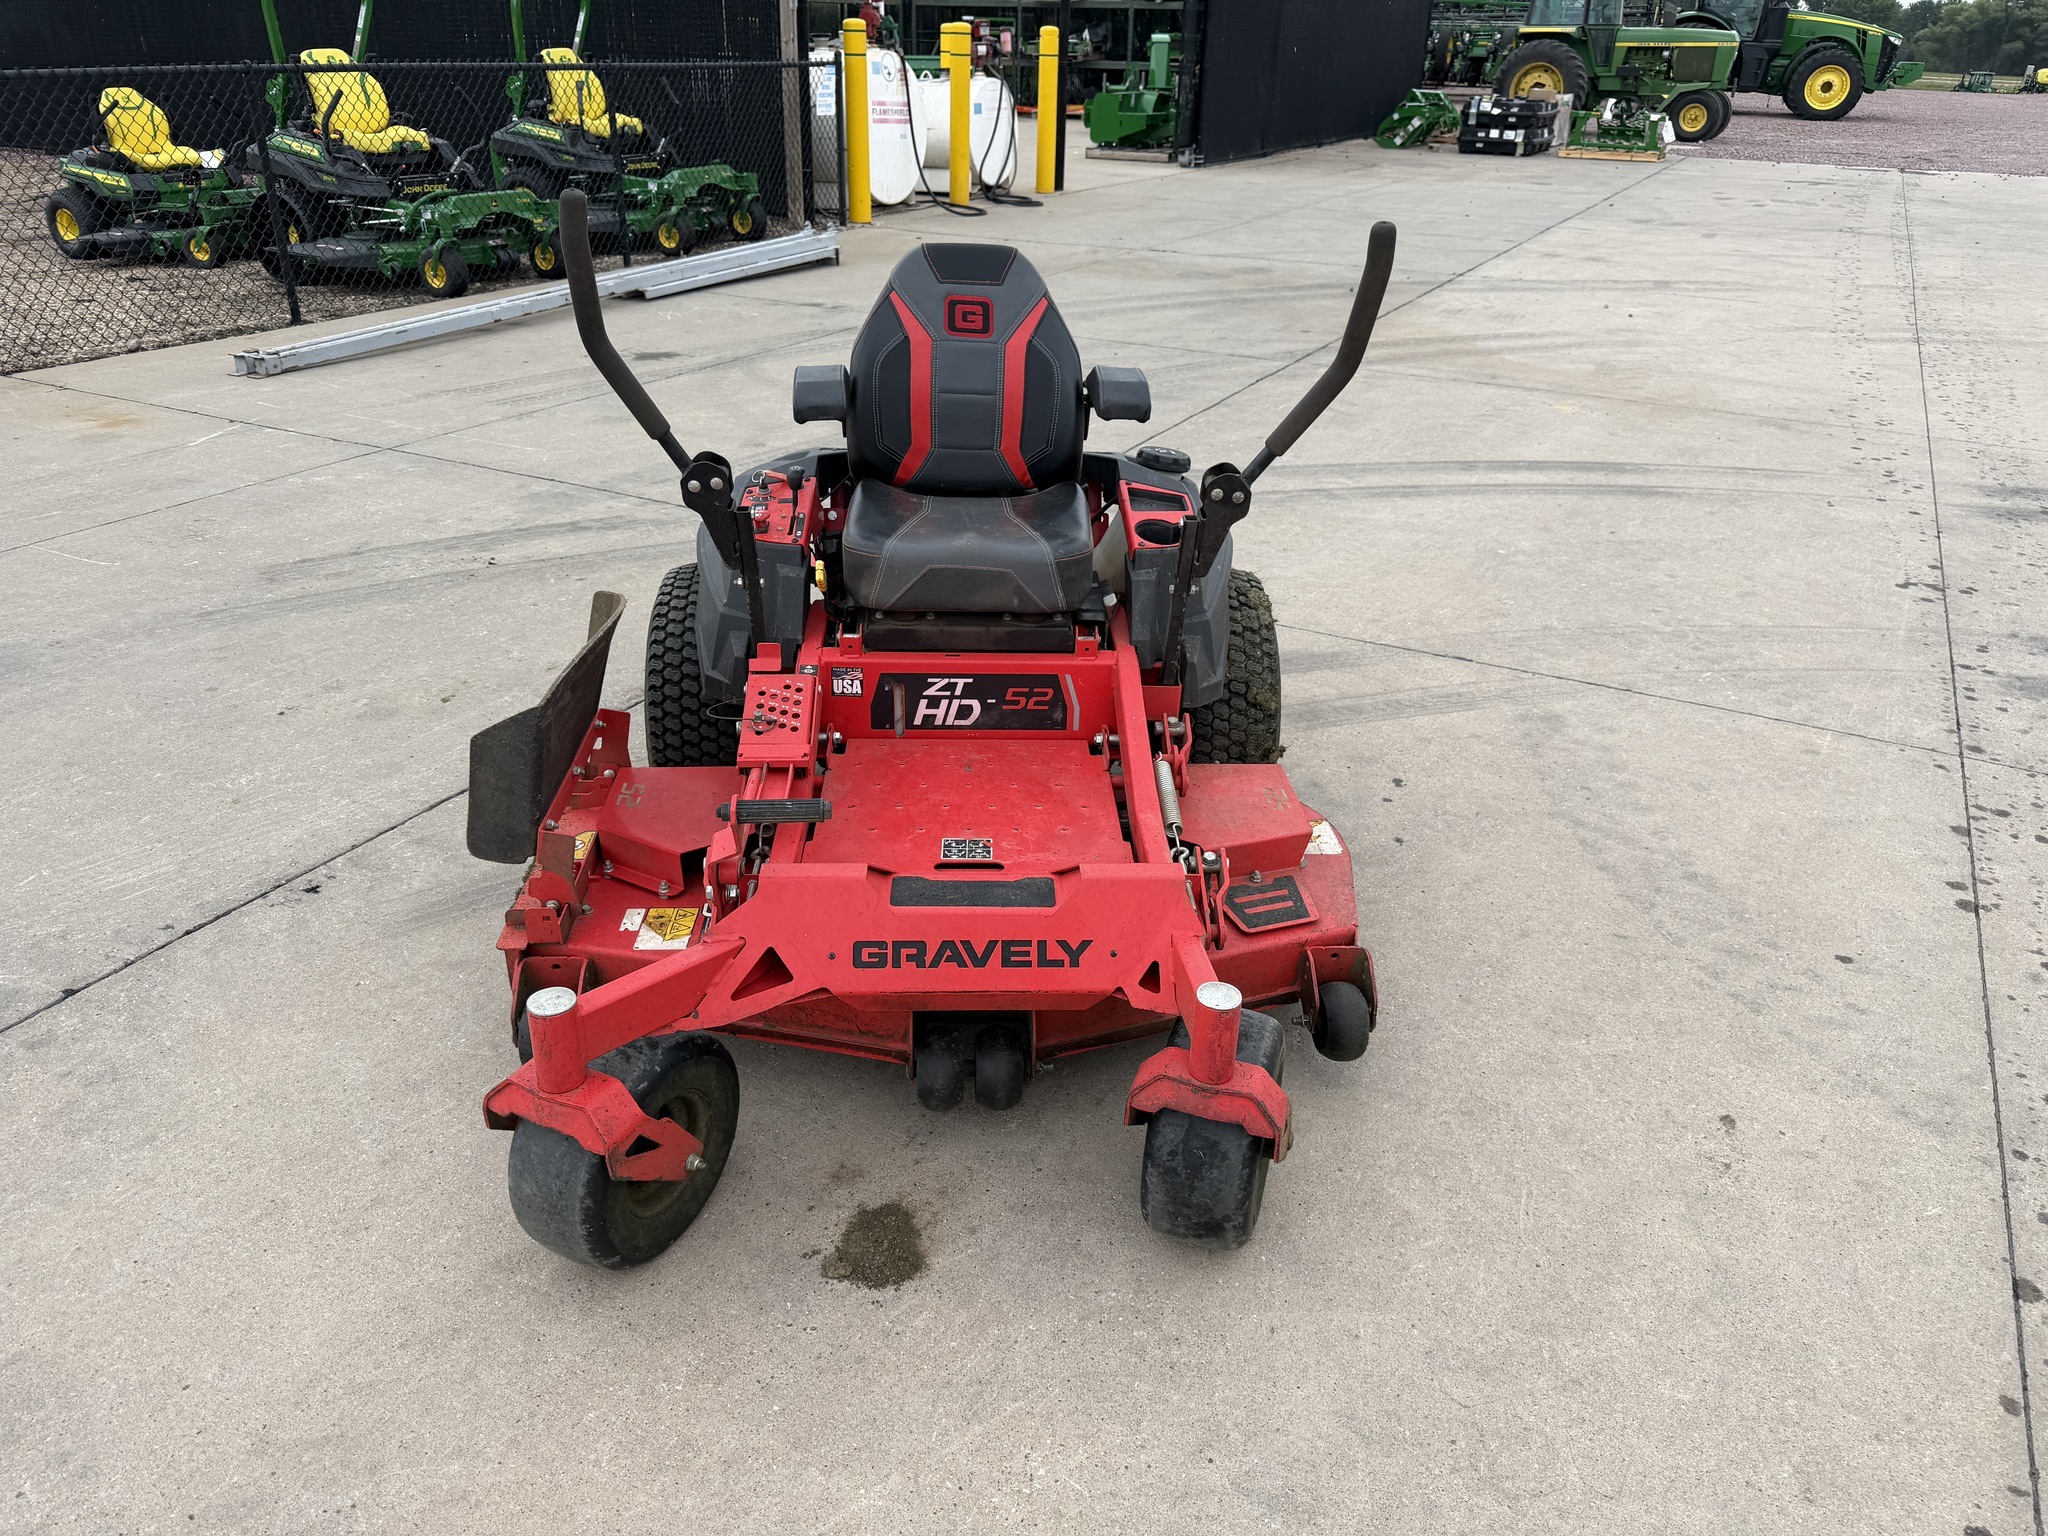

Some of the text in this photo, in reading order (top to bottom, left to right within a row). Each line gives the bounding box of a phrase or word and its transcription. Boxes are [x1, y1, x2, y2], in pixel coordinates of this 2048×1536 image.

[403, 183, 448, 194] JOHN DEERE
[832, 679, 862, 694] USA
[922, 678, 974, 696] ZT
[852, 939, 1095, 969] GRAVELY
